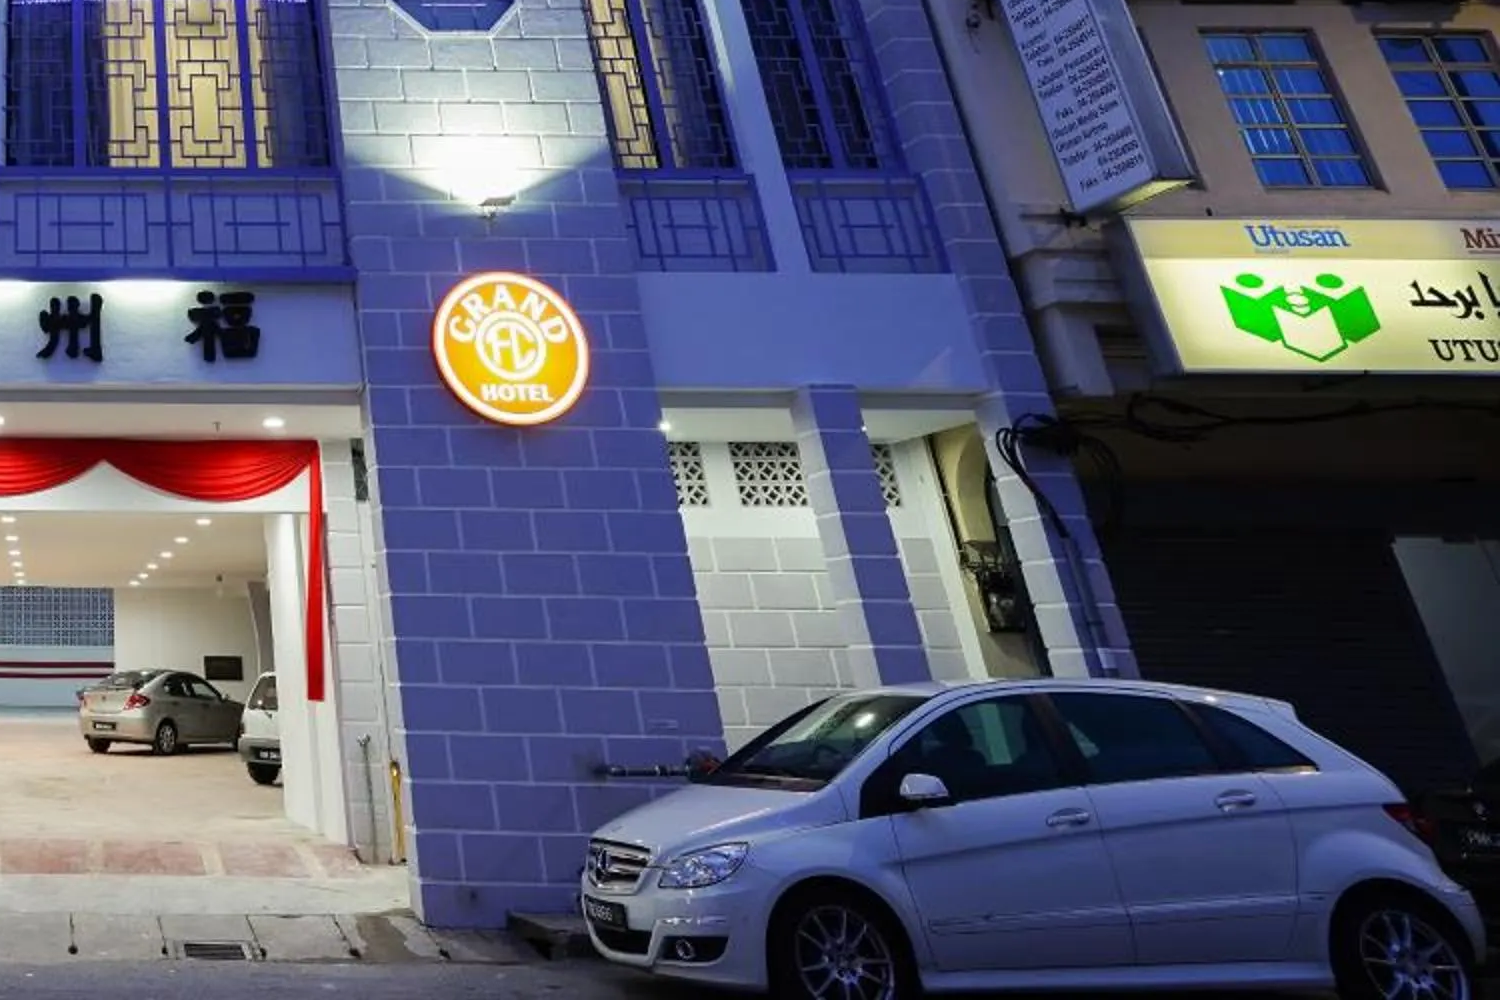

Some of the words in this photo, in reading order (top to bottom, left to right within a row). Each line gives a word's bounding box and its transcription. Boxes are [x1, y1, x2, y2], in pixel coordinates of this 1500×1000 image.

[1245, 225, 1351, 248] Utusan
[1460, 227, 1500, 249] Mi
[450, 283, 569, 344] GRAND
[1428, 338, 1500, 363] UTU
[481, 383, 554, 402] HOTEL
